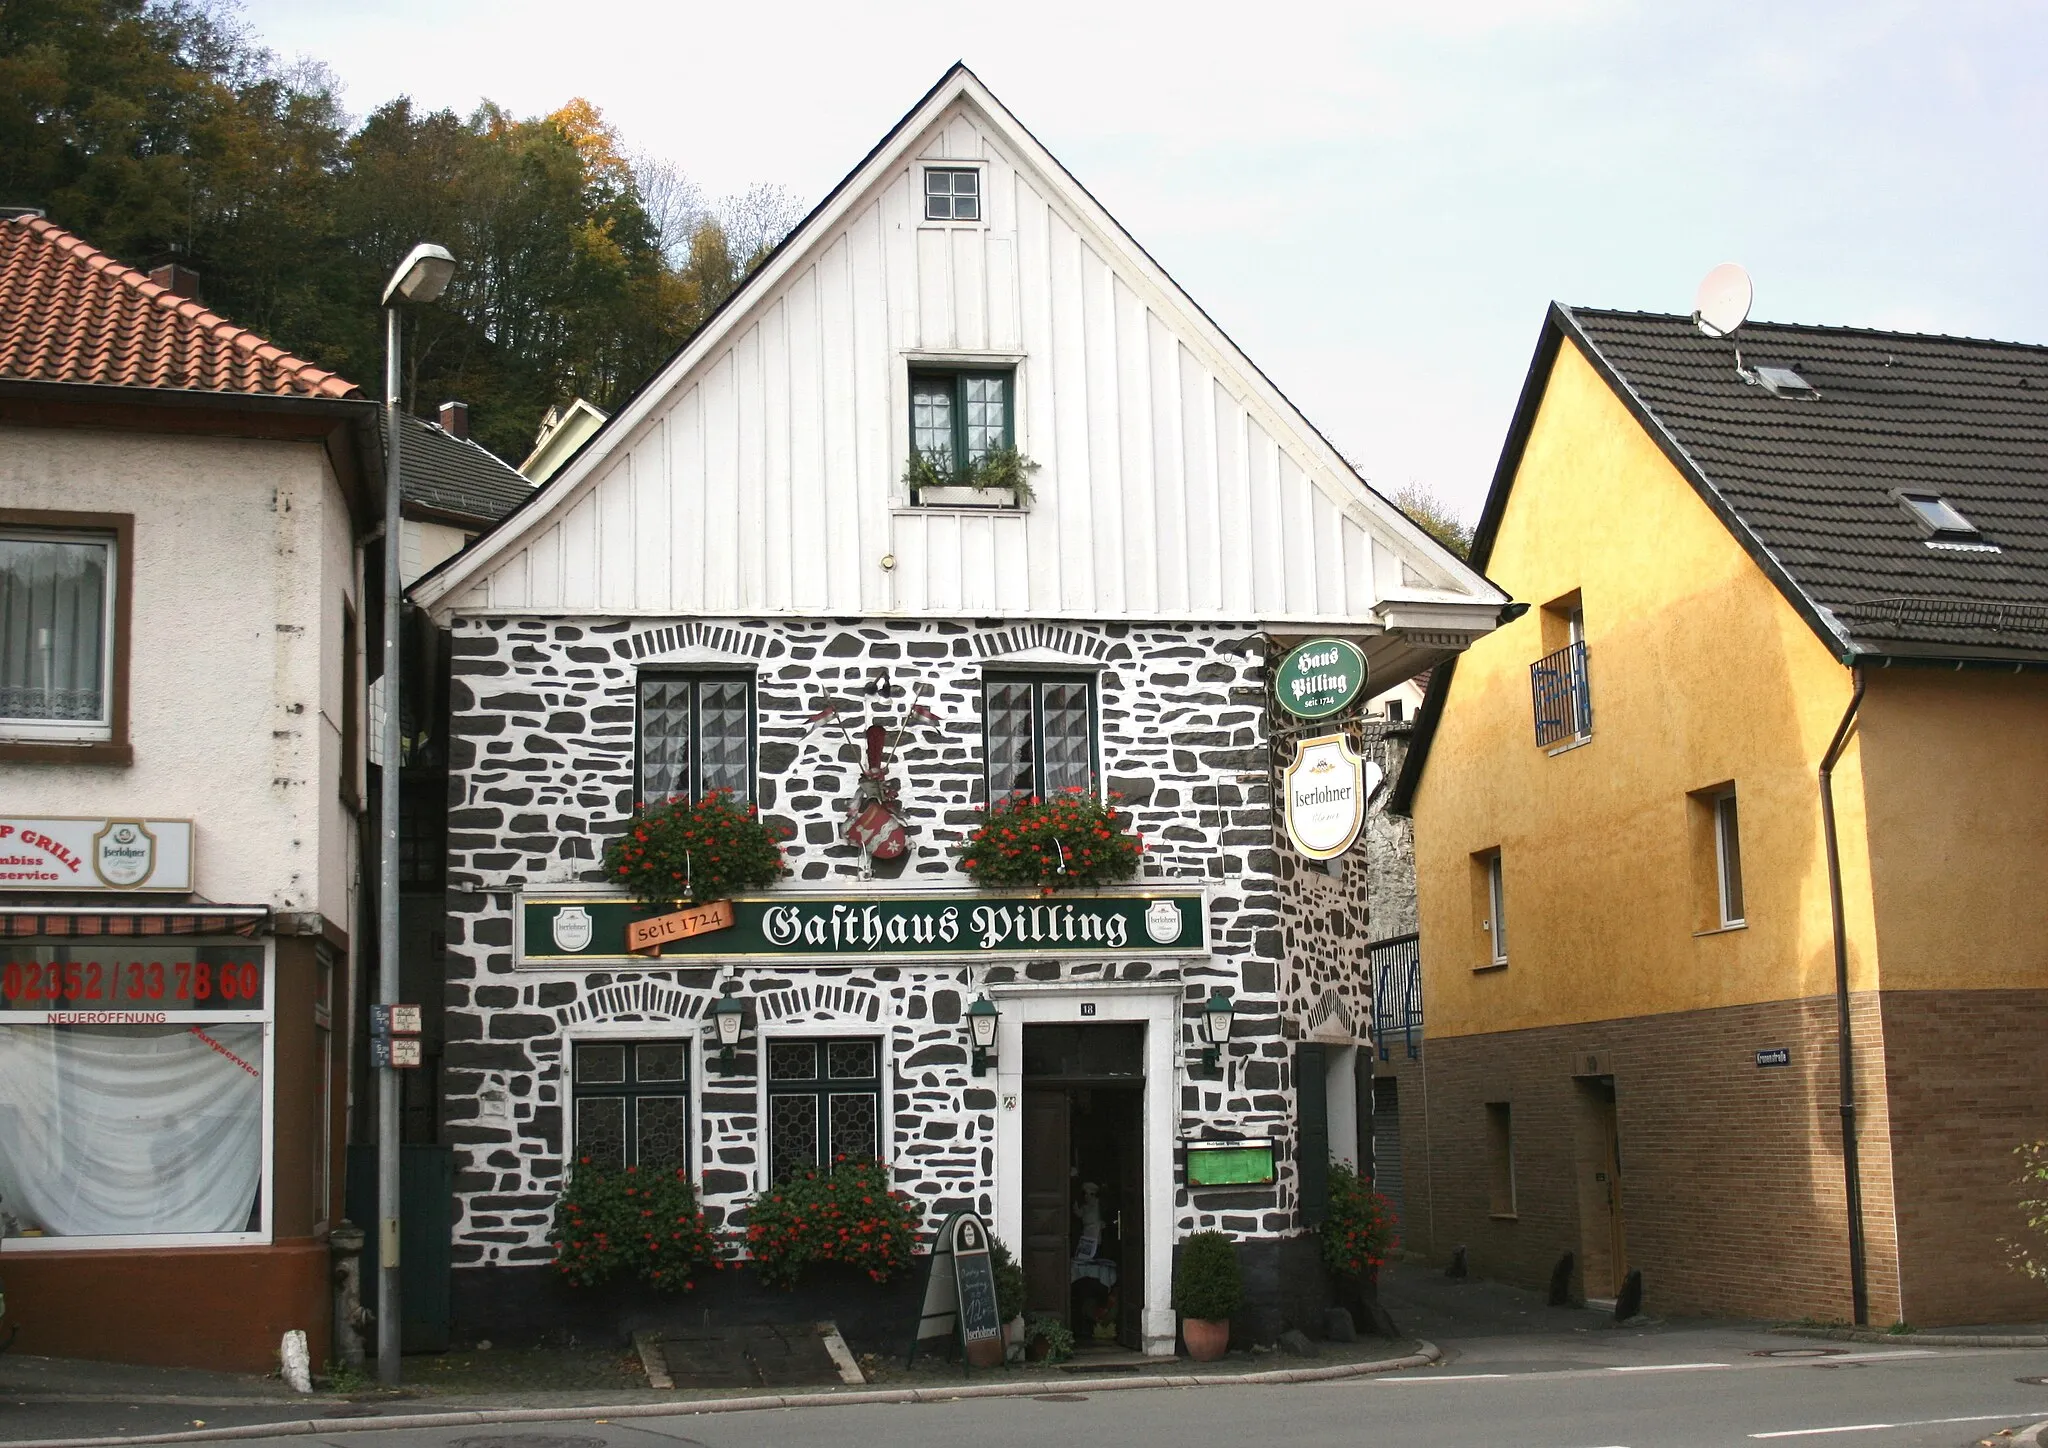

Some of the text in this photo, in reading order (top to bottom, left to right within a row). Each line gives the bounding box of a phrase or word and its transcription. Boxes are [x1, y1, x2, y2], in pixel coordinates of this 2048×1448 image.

[1298, 647, 1338, 675] Haus
[1291, 674, 1347, 701] Pilling
[1304, 696, 1335, 708] seit 1724
[1295, 785, 1352, 807] Iserlohner
[20, 829, 82, 873] GRILL
[104, 846, 146, 858] Iserlohner
[638, 911, 723, 942] seit 1724
[762, 904, 1128, 951] Gasthaus Pilling
[3, 962, 104, 1000] 02352
[127, 962, 165, 1000] 33
[174, 962, 212, 1000] 78
[219, 962, 259, 1000] 60
[47, 1010, 167, 1024] NEUERÖFFNUNG
[1083, 1004, 1093, 1015] 18
[966, 1325, 997, 1340] Iserlohner
